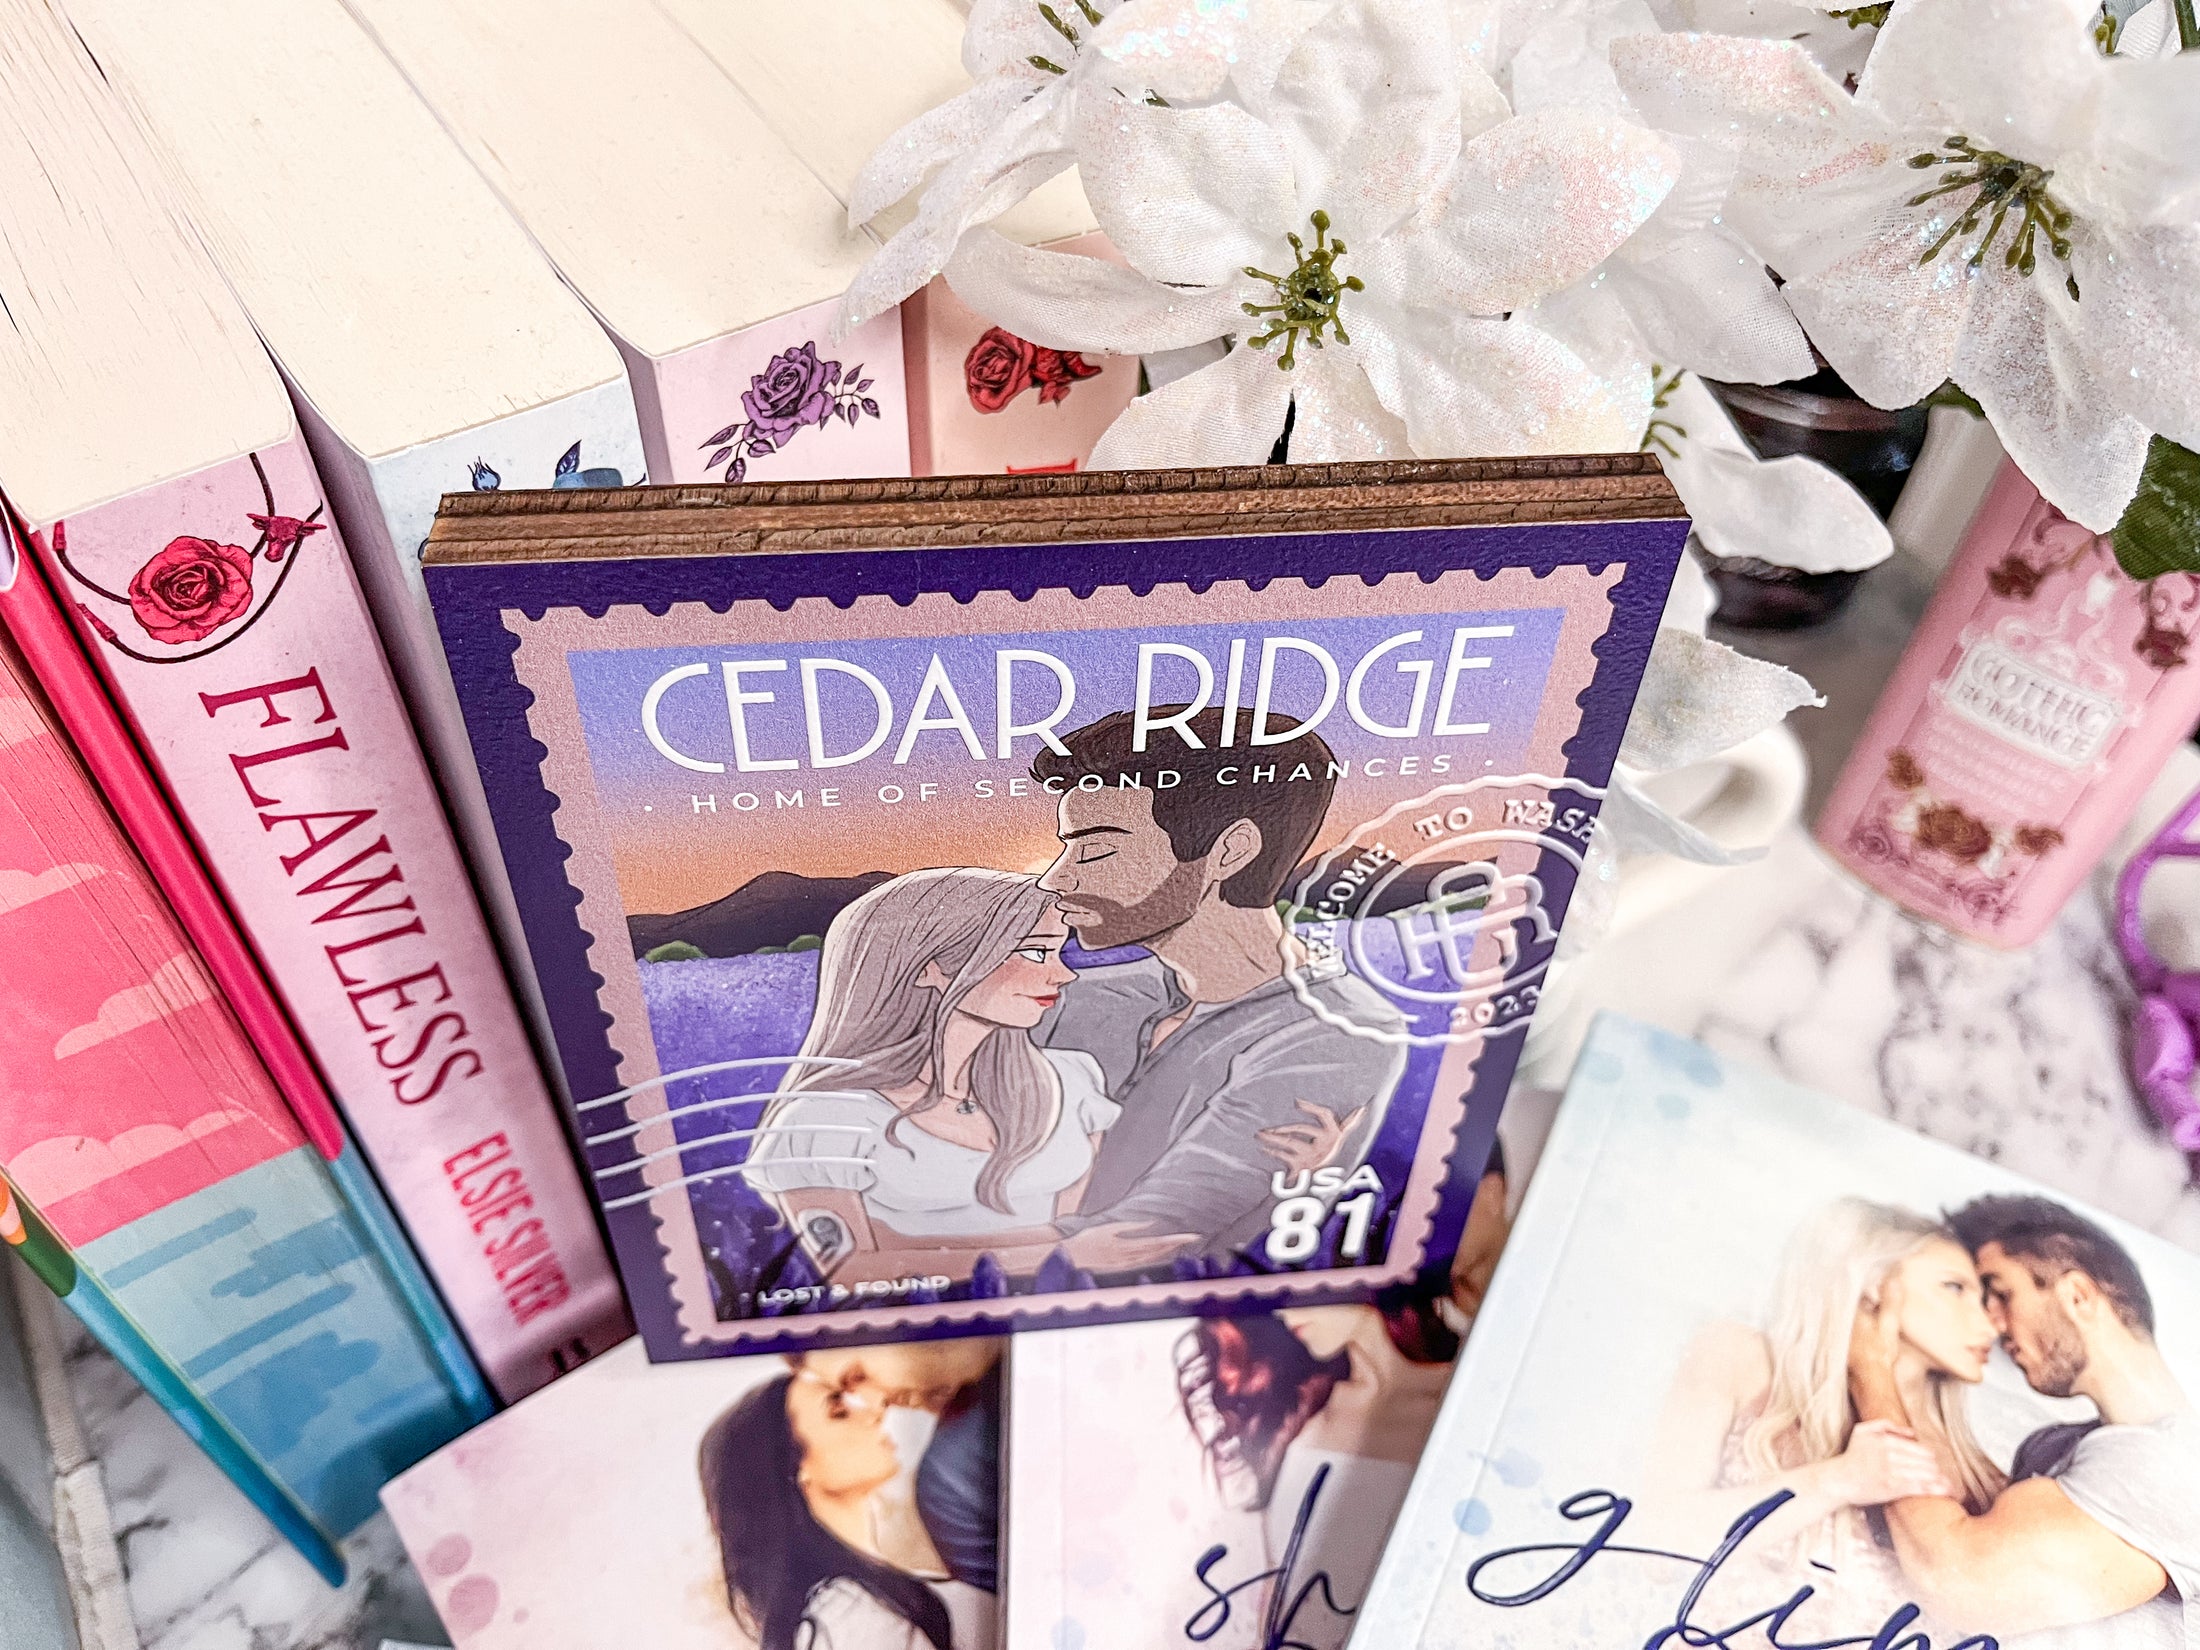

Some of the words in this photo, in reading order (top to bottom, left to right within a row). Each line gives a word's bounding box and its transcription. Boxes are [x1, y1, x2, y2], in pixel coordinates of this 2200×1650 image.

[641, 649, 1072, 773] CEDAR
[1132, 625, 1515, 753] RIDGE
[691, 788, 841, 814] HOME
[878, 782, 939, 804] OF
[974, 769, 1183, 799] SECOND
[1216, 755, 1452, 787] CHANCES
[197, 666, 485, 1107] FLAWLESS
[1306, 842, 1397, 979] WELCOME
[1413, 806, 1475, 841] TO
[443, 1131, 535, 1236] ELSIE
[1271, 1165, 1384, 1199] USA
[1265, 1191, 1376, 1264] 81
[757, 1284, 824, 1307] LOST
[831, 1283, 849, 1299] &
[855, 1275, 951, 1297] FOUND
